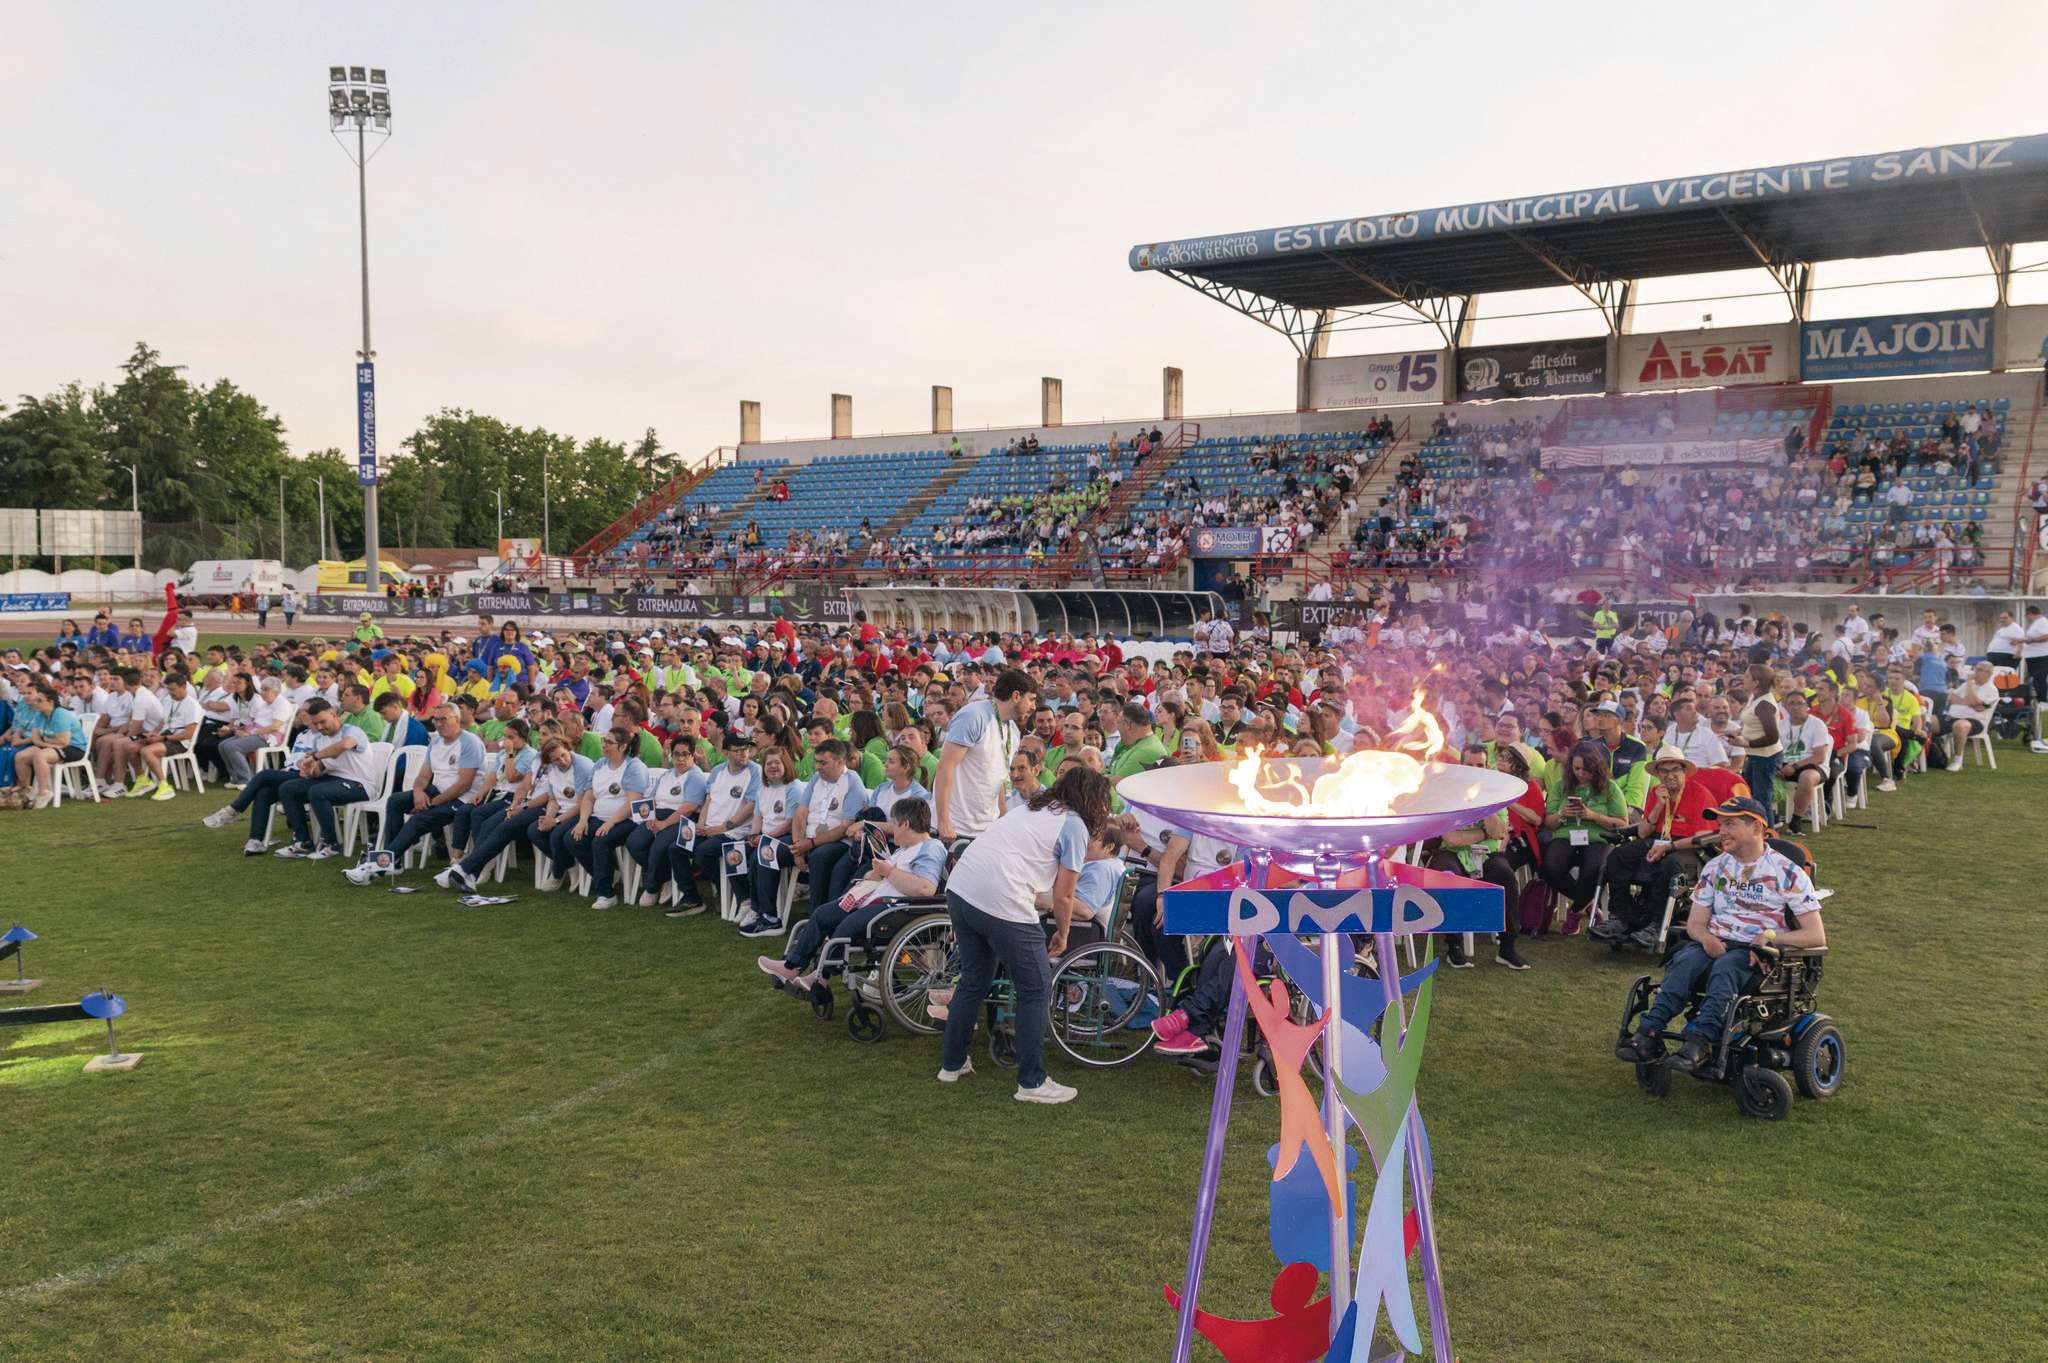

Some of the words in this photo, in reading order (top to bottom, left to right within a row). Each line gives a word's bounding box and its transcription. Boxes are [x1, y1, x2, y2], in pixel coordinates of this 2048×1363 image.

[1273, 212, 1419, 251] ESTADIO
[1434, 187, 1639, 233] MUNICIPAL
[1651, 162, 1852, 206] VICENTE
[1871, 141, 2014, 181] SANZ
[1167, 234, 1256, 255] Ayuntamiento
[1205, 242, 1258, 260] BENITO
[1806, 318, 1989, 360] MAJOIN
[1638, 335, 1772, 383] ALSAT
[1369, 363, 1401, 374] Grupo
[1397, 354, 1437, 392] 15
[342, 599, 388, 613] EXTREMADURA
[478, 597, 531, 610] EXTREMADURA
[637, 599, 698, 613] EXTREMADURA
[1729, 879, 1764, 893] Plena
